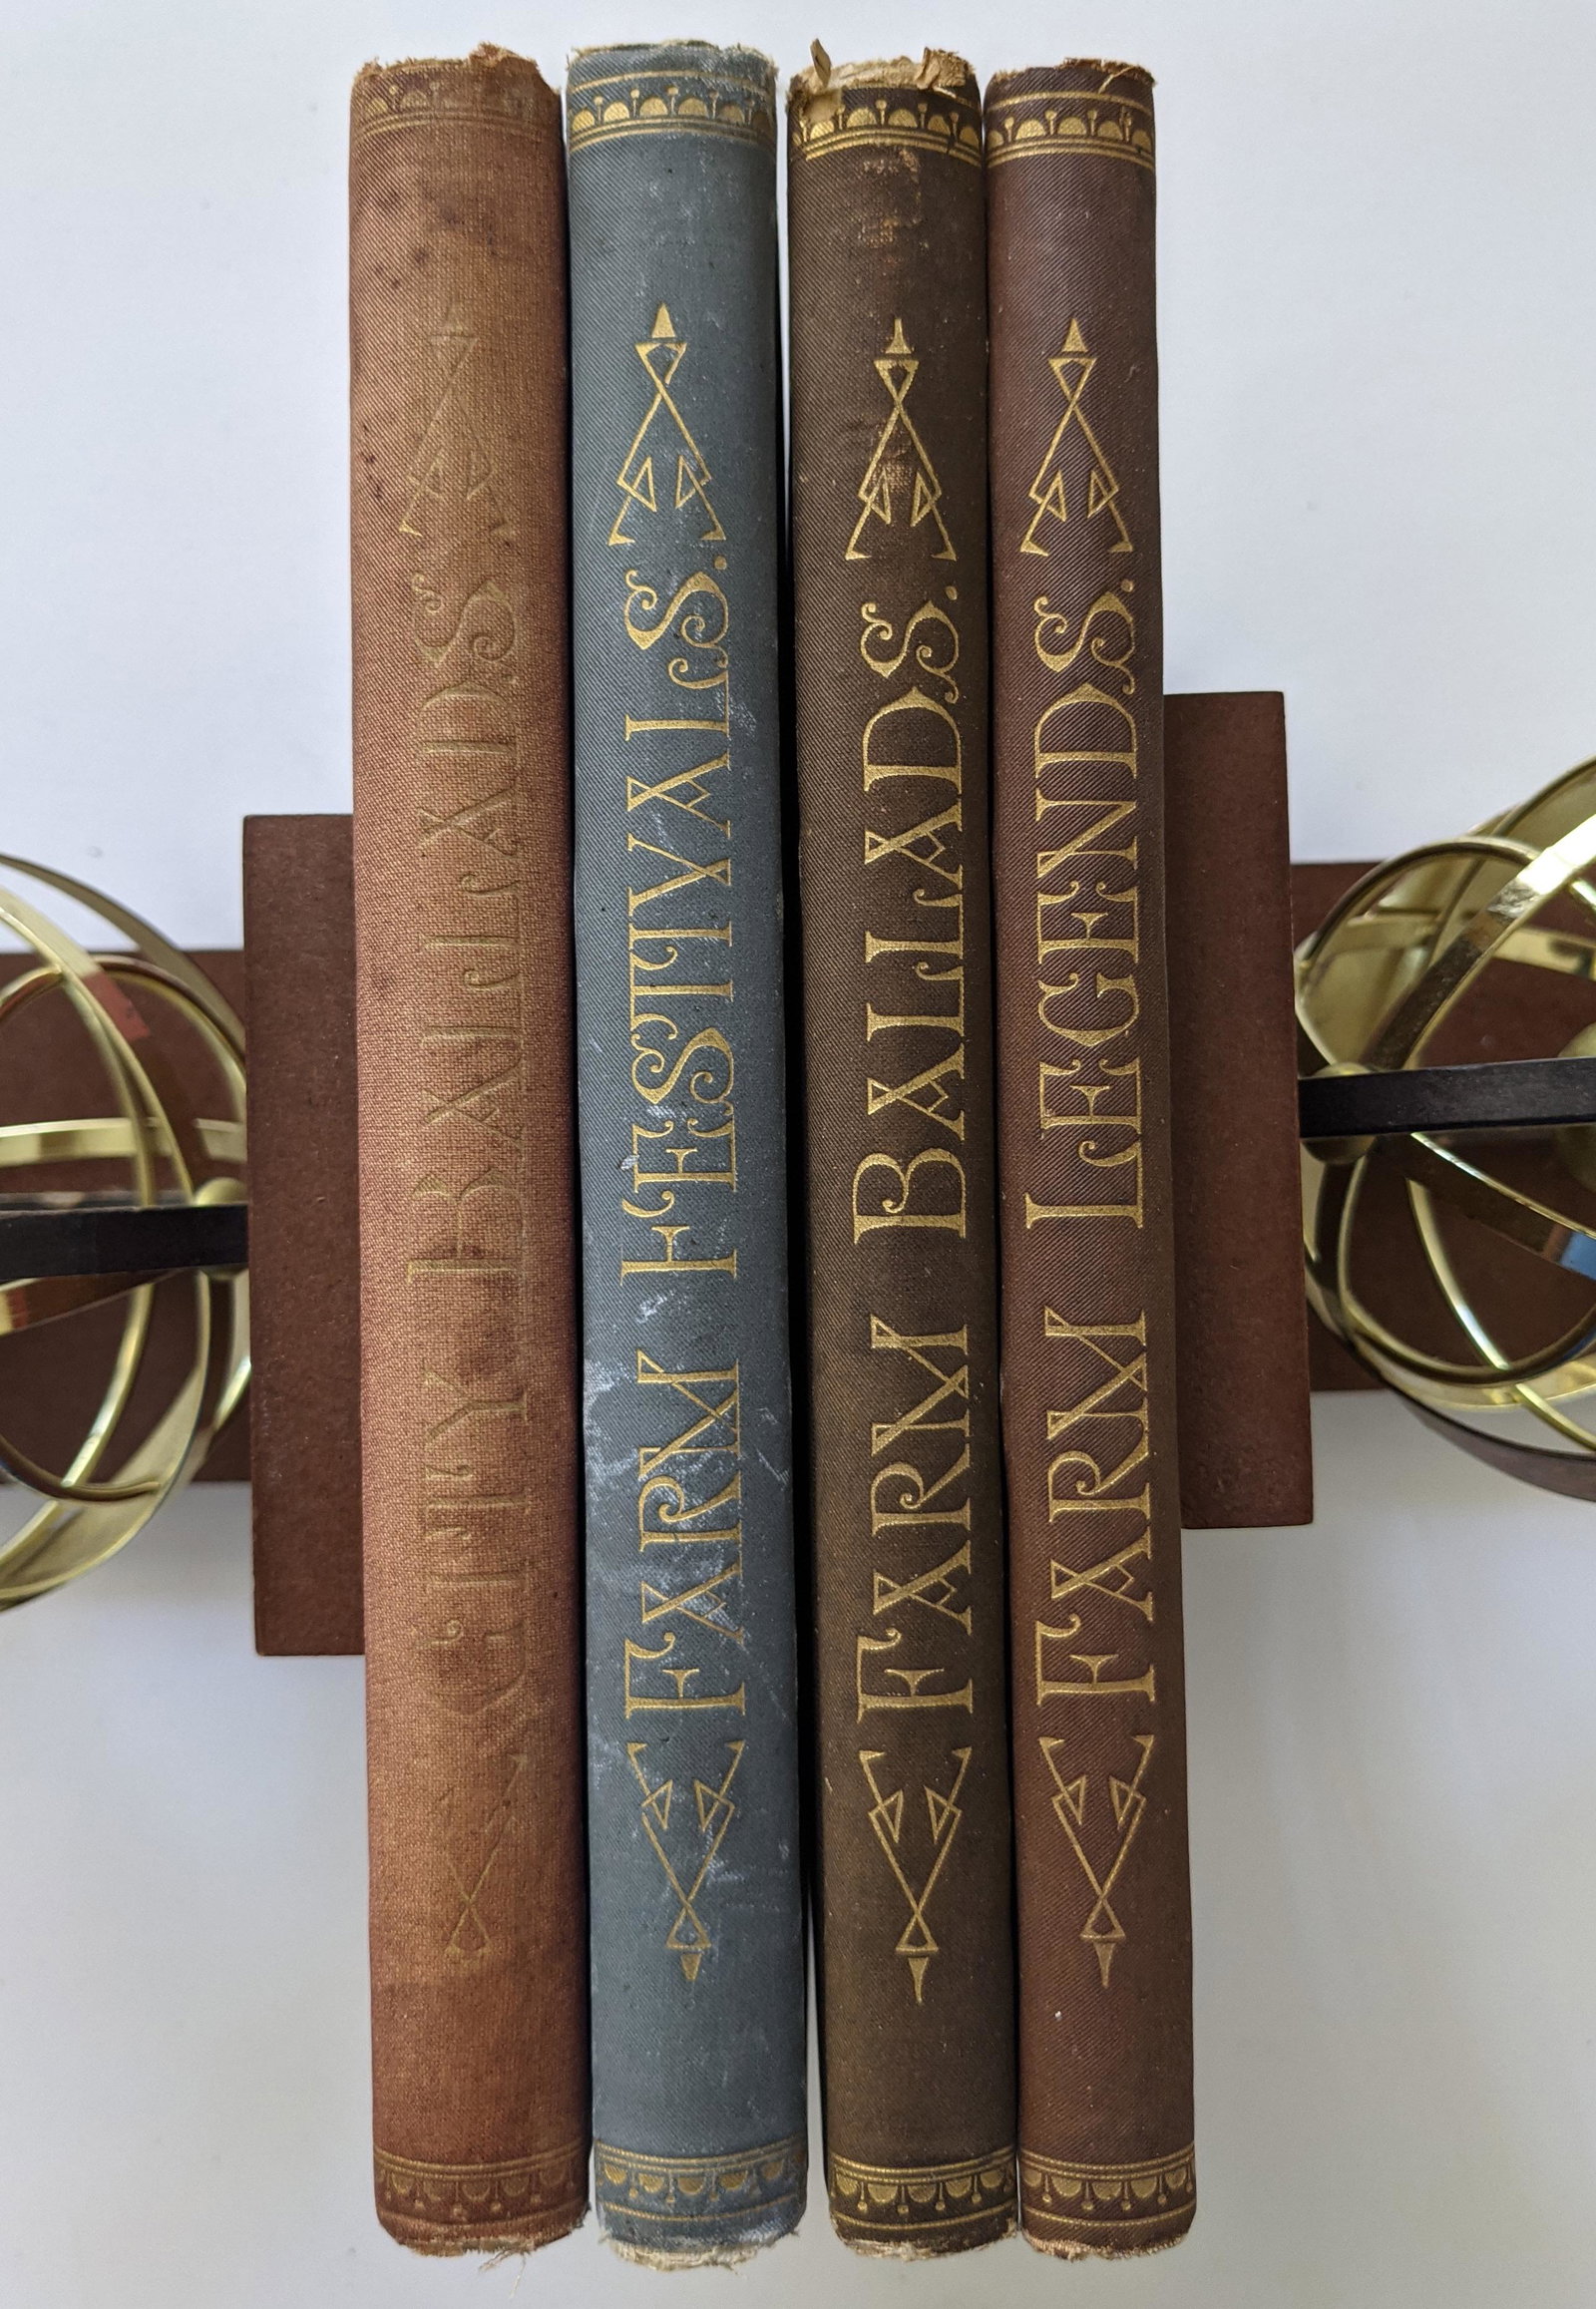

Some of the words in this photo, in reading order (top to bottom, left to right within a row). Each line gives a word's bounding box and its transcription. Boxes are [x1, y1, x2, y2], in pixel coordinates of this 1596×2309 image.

[620, 555, 738, 1276] FESTIVALS.
[851, 583, 969, 1241] BALLADS.
[1022, 577, 1146, 1230] LEGENDS.
[622, 1350, 746, 1719] FARM
[855, 1316, 975, 1721] FARM
[1033, 1305, 1157, 1705] FARM
